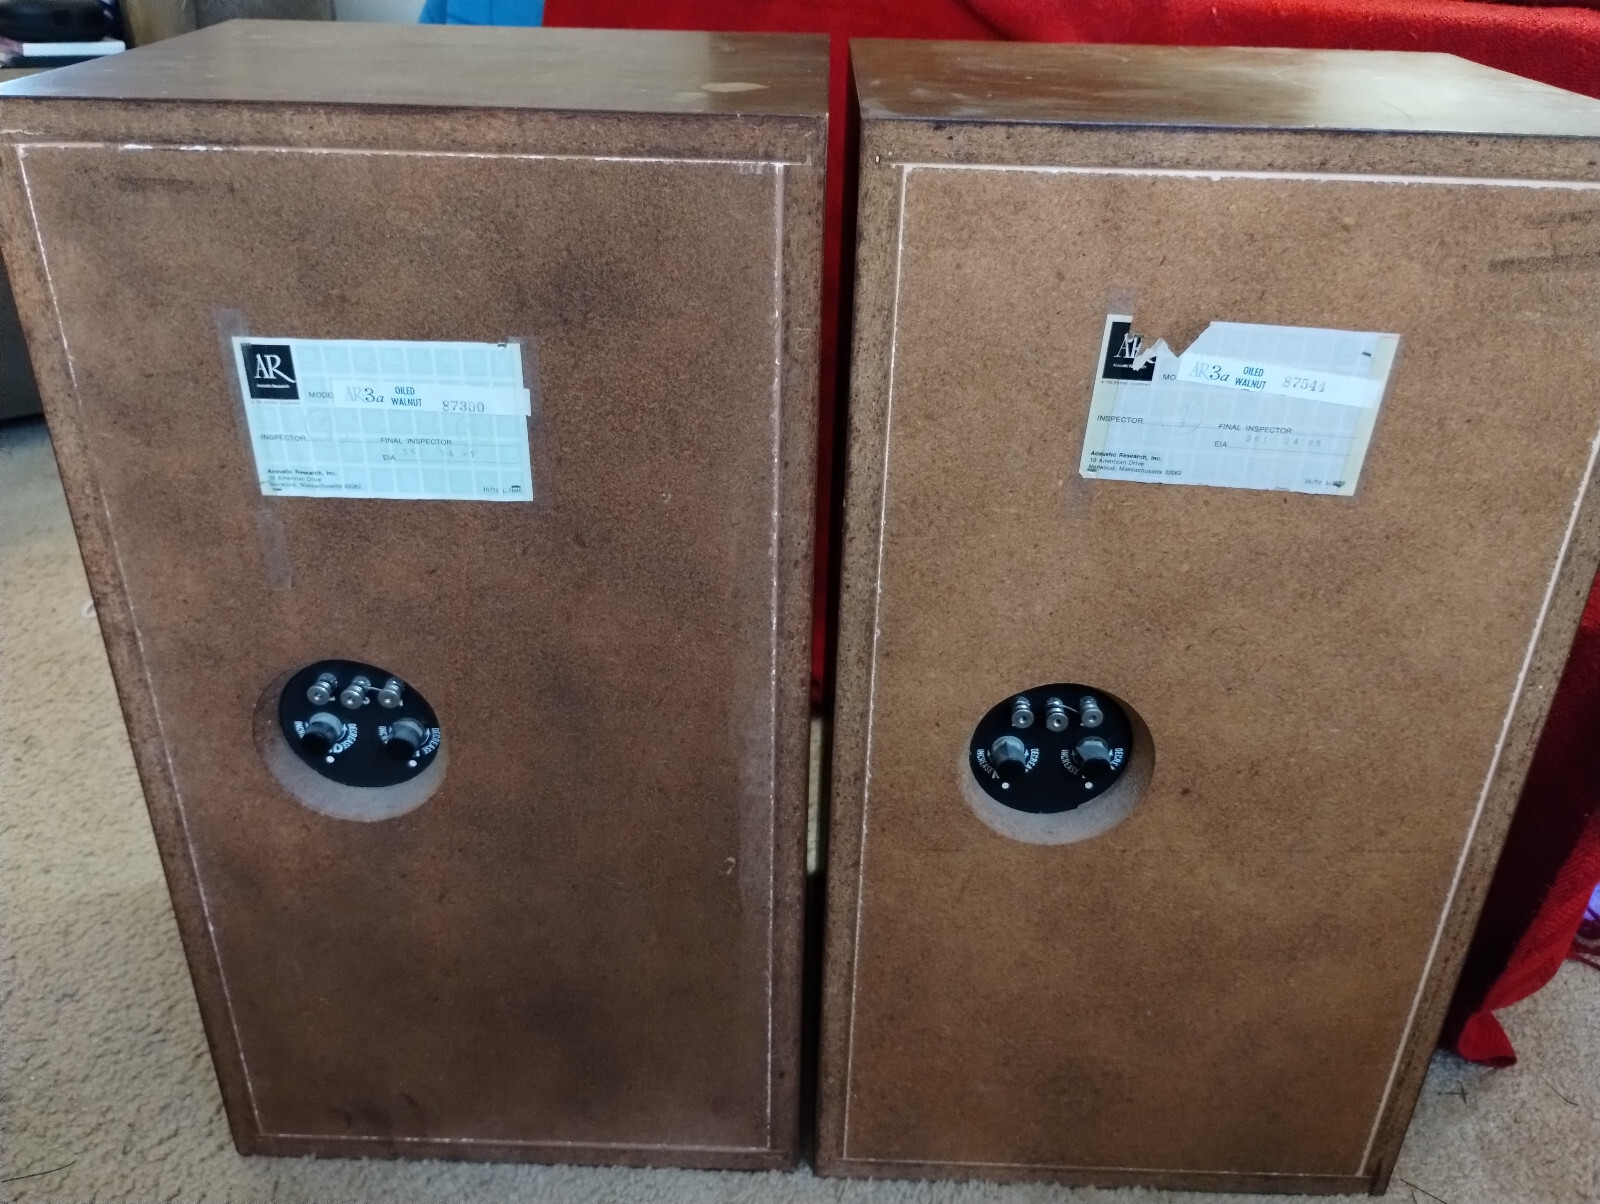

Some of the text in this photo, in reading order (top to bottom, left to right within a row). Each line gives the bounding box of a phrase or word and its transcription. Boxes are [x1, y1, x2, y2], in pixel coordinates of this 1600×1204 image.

[254, 352, 296, 384] AR
[1243, 366, 1265, 377] OILED
[1234, 377, 1267, 390] WALNUT
[1282, 376, 1327, 393] 87544
[308, 391, 334, 399] MODE
[394, 386, 415, 395] OILED
[391, 397, 422, 407] WALNUT
[442, 400, 485, 413] 87300
[1097, 415, 1144, 424] INSPECTOR
[1218, 423, 1293, 434] FINAL INSPECTOR
[260, 434, 307, 442] INSPECTOR
[407, 438, 452, 446] INSPECTOR
[1090, 450, 1117, 458] Acoustic
[976, 748, 994, 774] INCREASE
[1060, 749, 1080, 776] INCREASE
